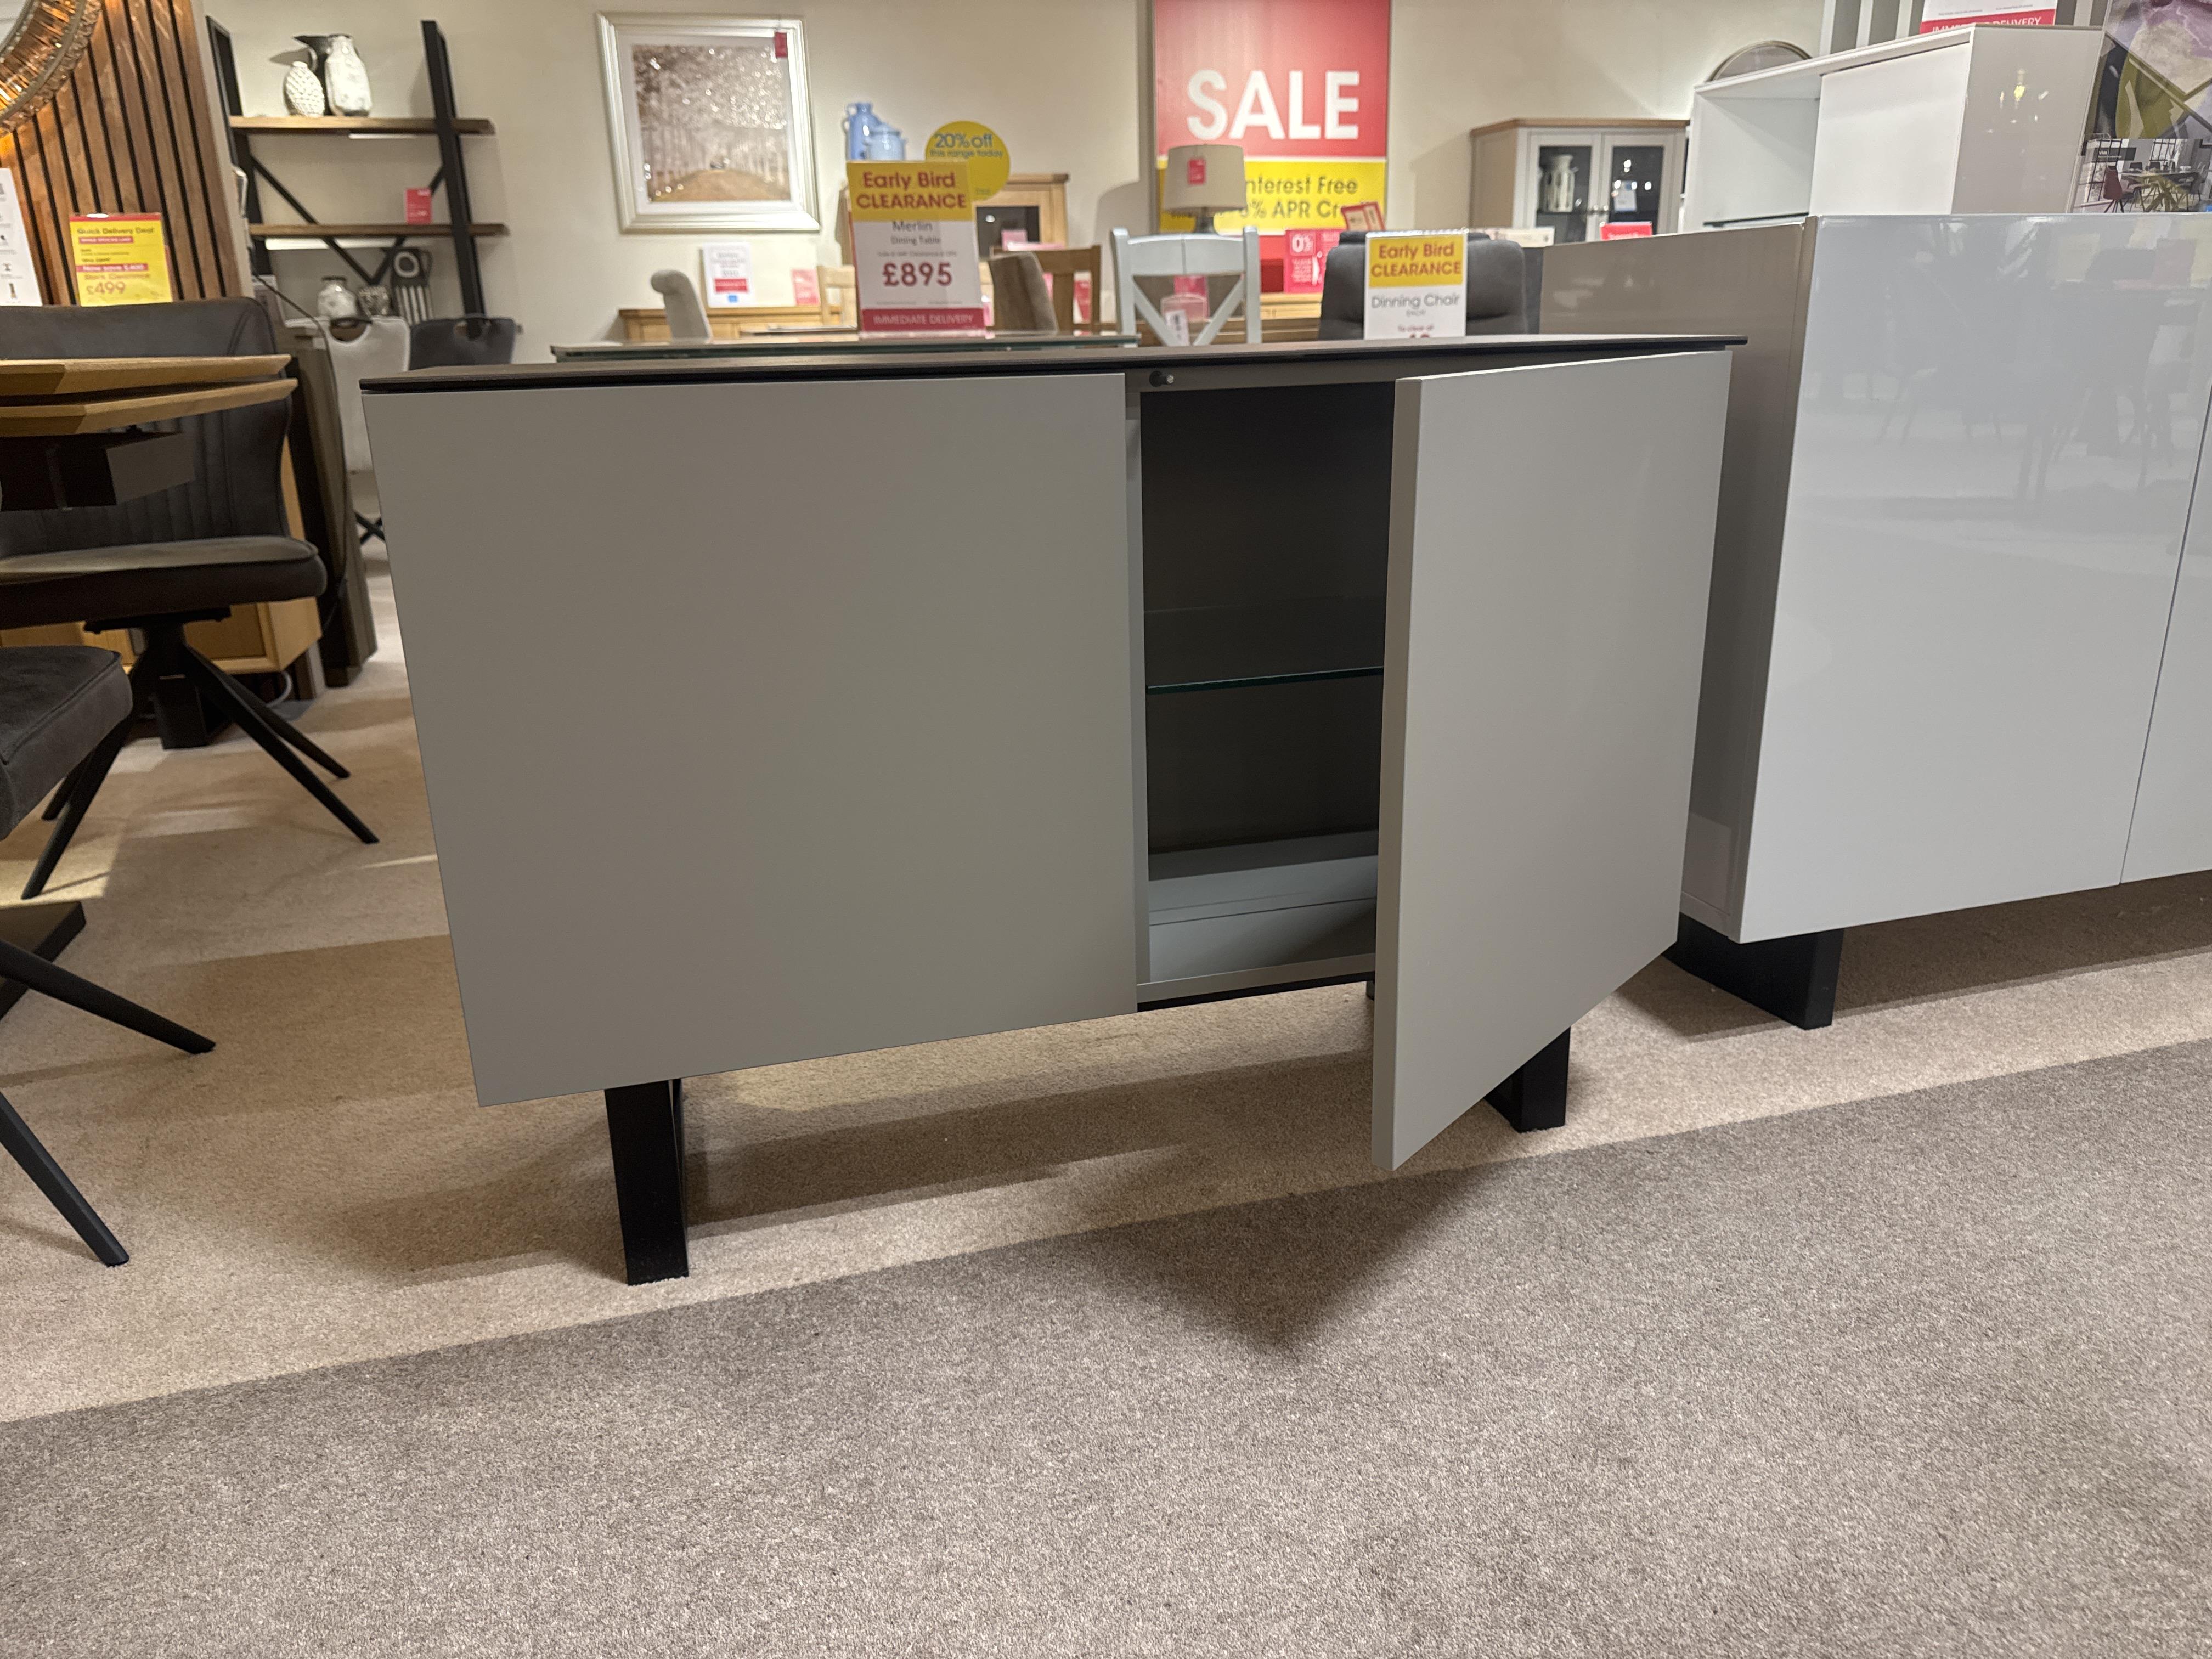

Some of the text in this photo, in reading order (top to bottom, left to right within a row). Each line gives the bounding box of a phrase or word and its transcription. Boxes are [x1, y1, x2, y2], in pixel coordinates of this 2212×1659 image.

[1186, 69, 1359, 140] SALE
[934, 133, 992, 148] 20% off
[947, 150, 974, 159] range
[975, 150, 1003, 158] today
[862, 171, 956, 191] Early Bird
[1245, 175, 1358, 194] nterest Free
[856, 194, 966, 209] CLEARANCE
[1272, 200, 1311, 218] APR
[892, 221, 933, 231] Merlin
[890, 236, 941, 246] Dining Table
[1379, 242, 1455, 259] Early Bird
[883, 262, 952, 286] £895
[1372, 261, 1462, 277] CLEARANCE
[87, 281, 126, 295] £499
[1372, 292, 1460, 309] Dinning Chair
[873, 314, 974, 325] IMMEDIATE DELIVERY
